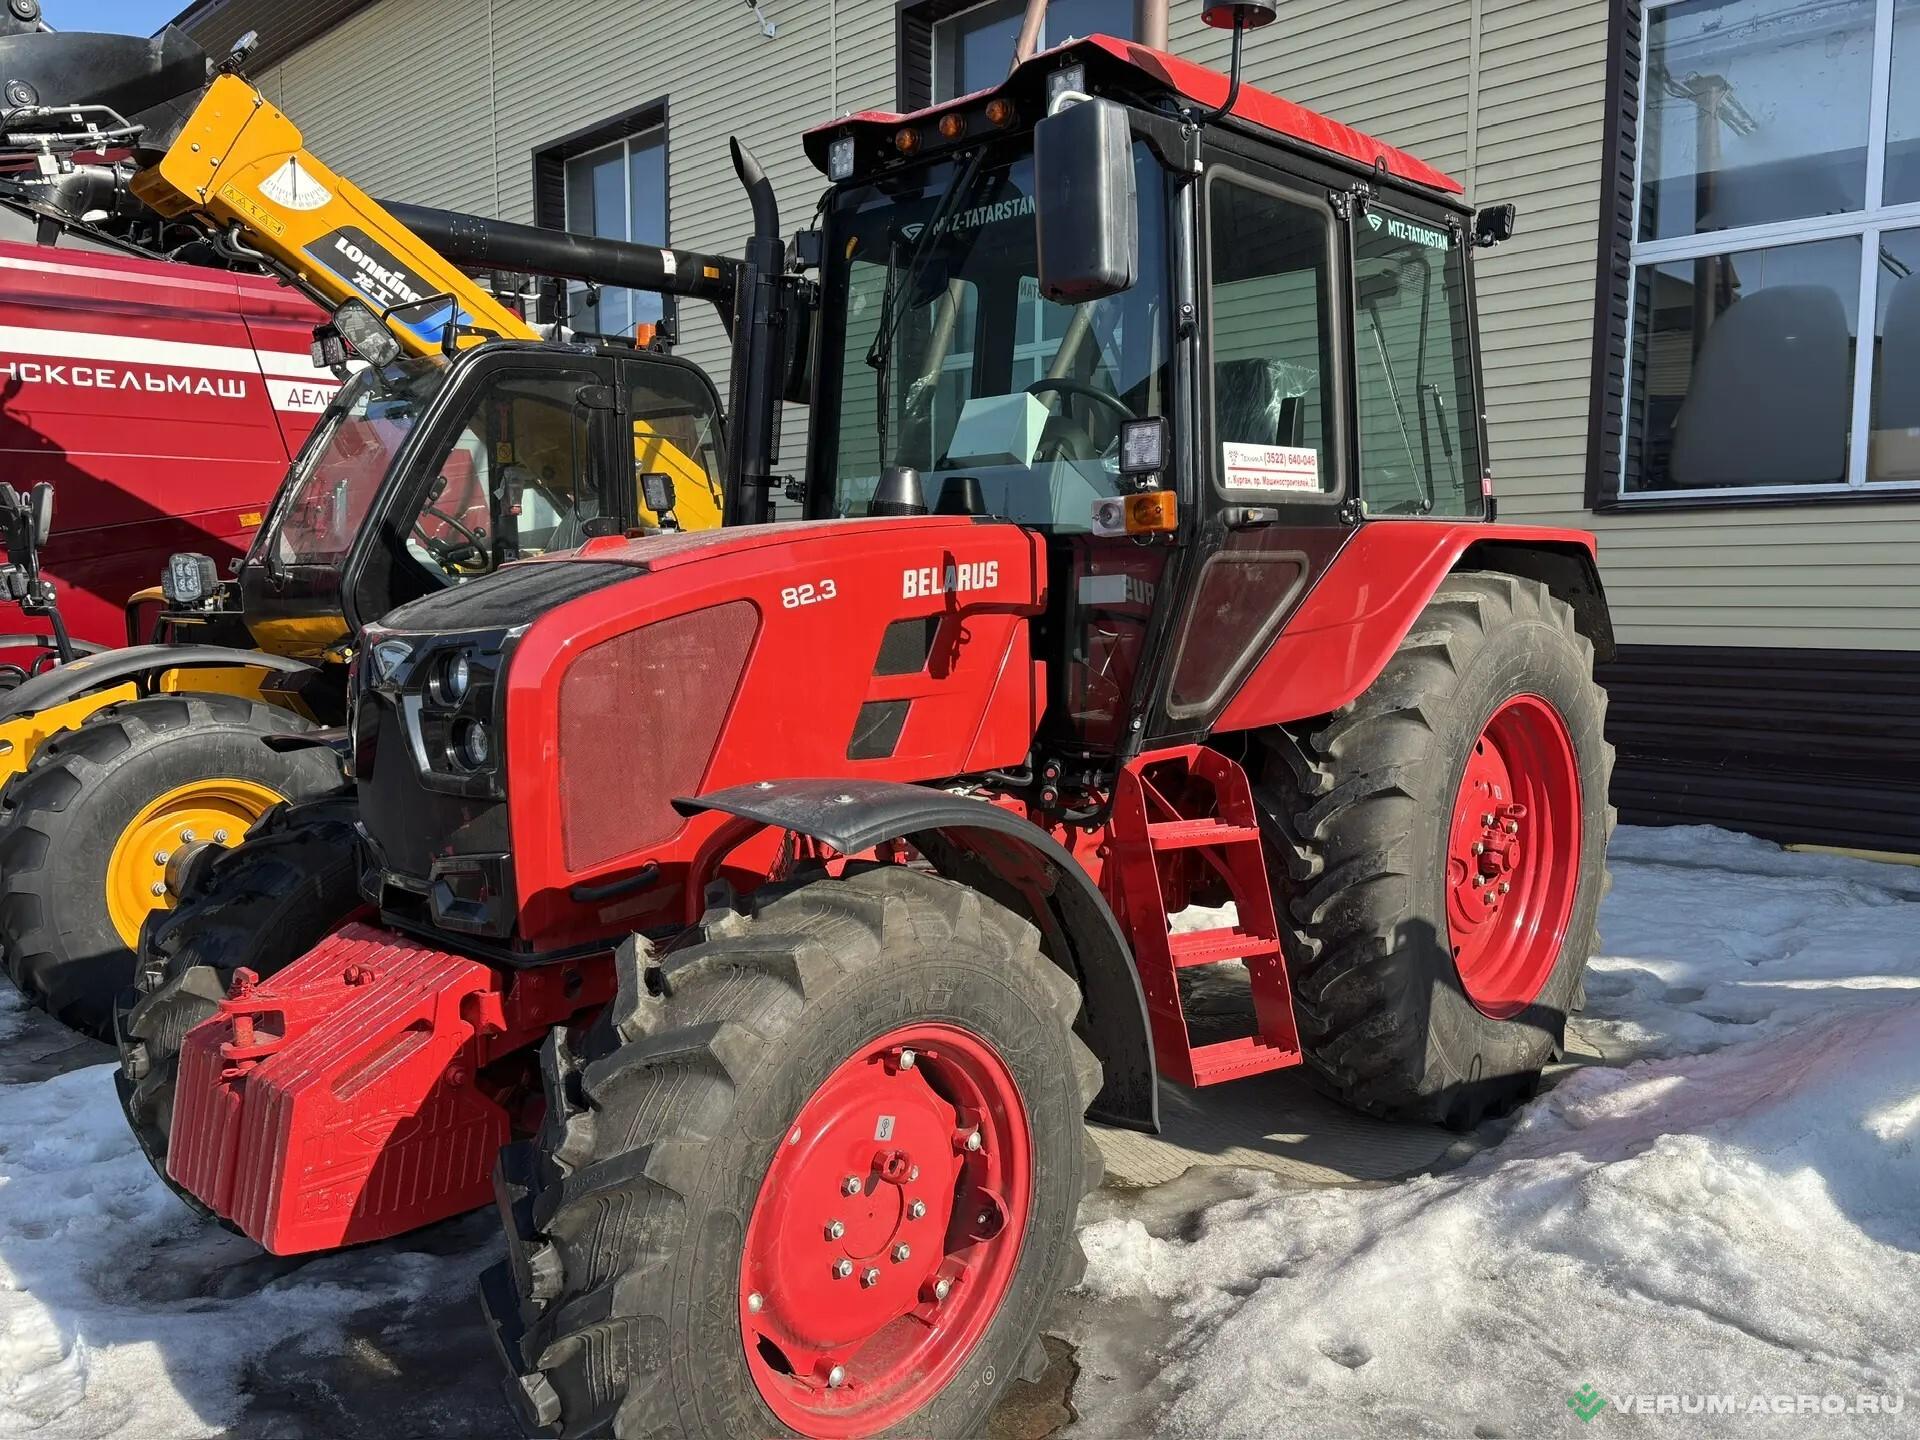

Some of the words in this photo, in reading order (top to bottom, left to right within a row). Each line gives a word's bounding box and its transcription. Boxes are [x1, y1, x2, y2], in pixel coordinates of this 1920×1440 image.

[1387, 218, 1449, 251] MTZ-TATARSTAN
[1263, 452, 1287, 467] (3522)
[781, 579, 837, 609] 82.3
[902, 560, 999, 600] BELARUS
